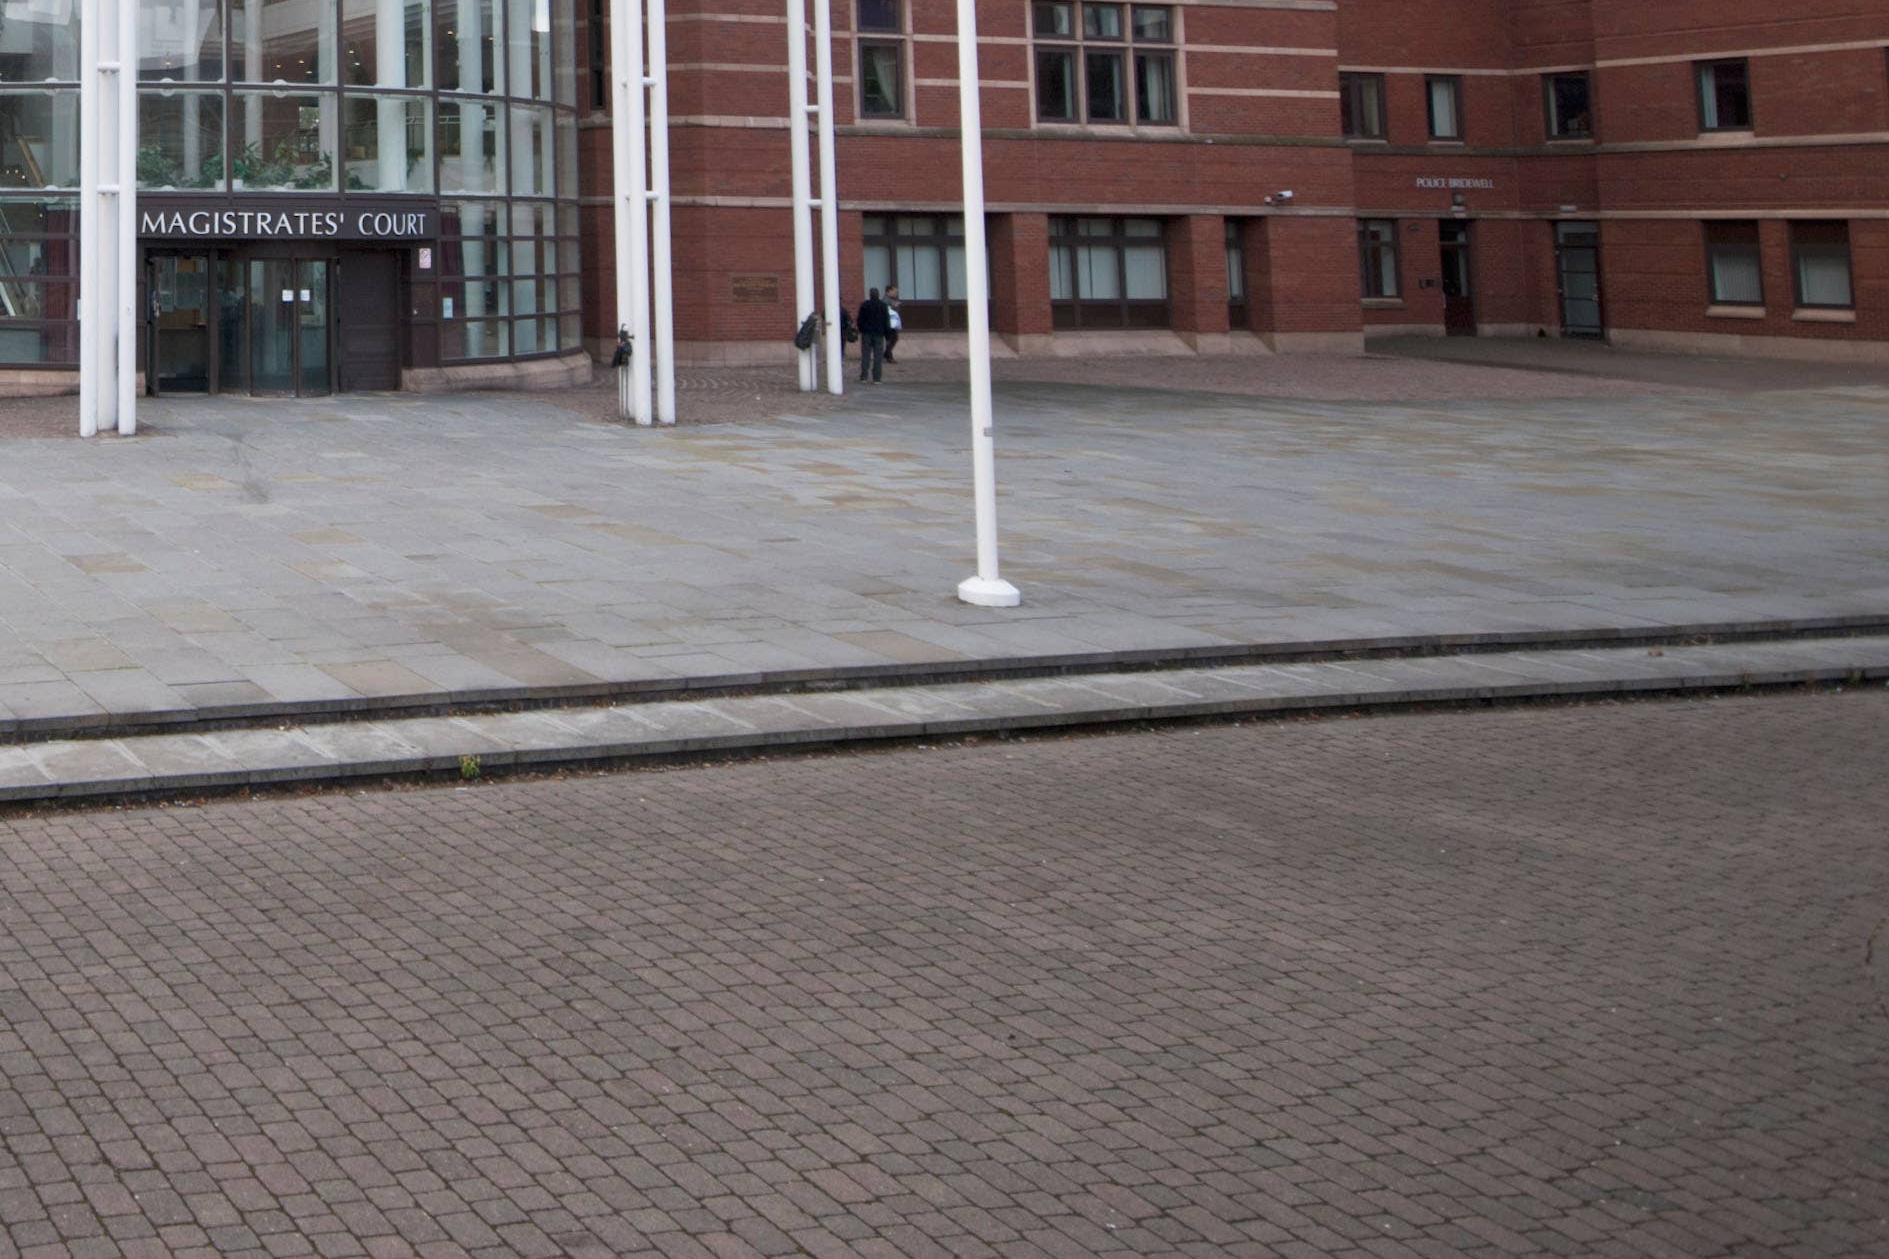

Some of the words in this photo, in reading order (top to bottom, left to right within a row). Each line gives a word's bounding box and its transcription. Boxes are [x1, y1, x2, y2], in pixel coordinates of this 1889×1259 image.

[1416, 177, 1446, 189] POLICE
[141, 211, 344, 235] MAGISTRATES'
[358, 213, 426, 236] COURT
